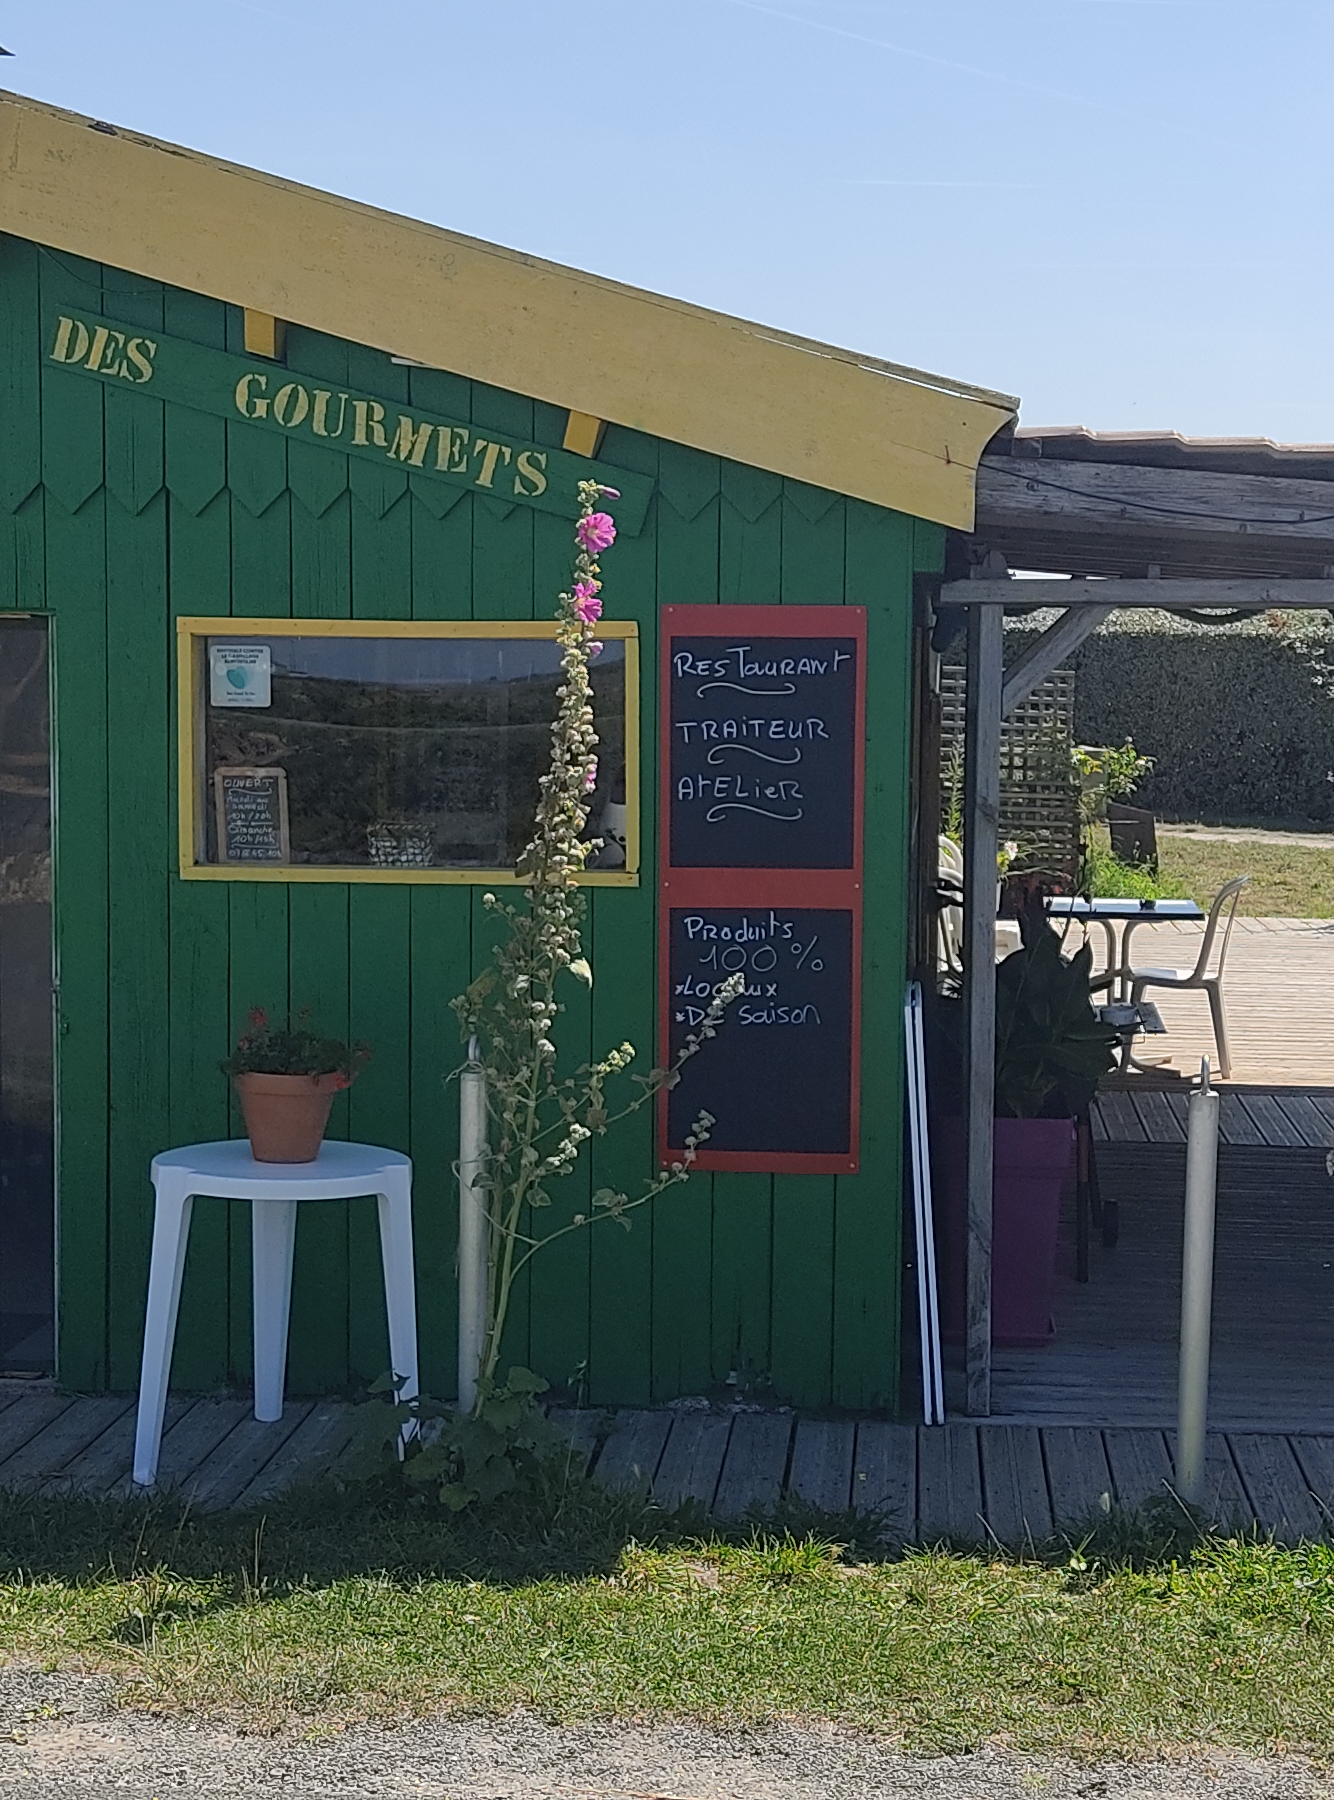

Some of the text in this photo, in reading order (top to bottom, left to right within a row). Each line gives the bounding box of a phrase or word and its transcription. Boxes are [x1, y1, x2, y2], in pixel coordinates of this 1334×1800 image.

[49, 316, 549, 497] DES GOURMETS
[224, 779, 274, 787] OUVERT
